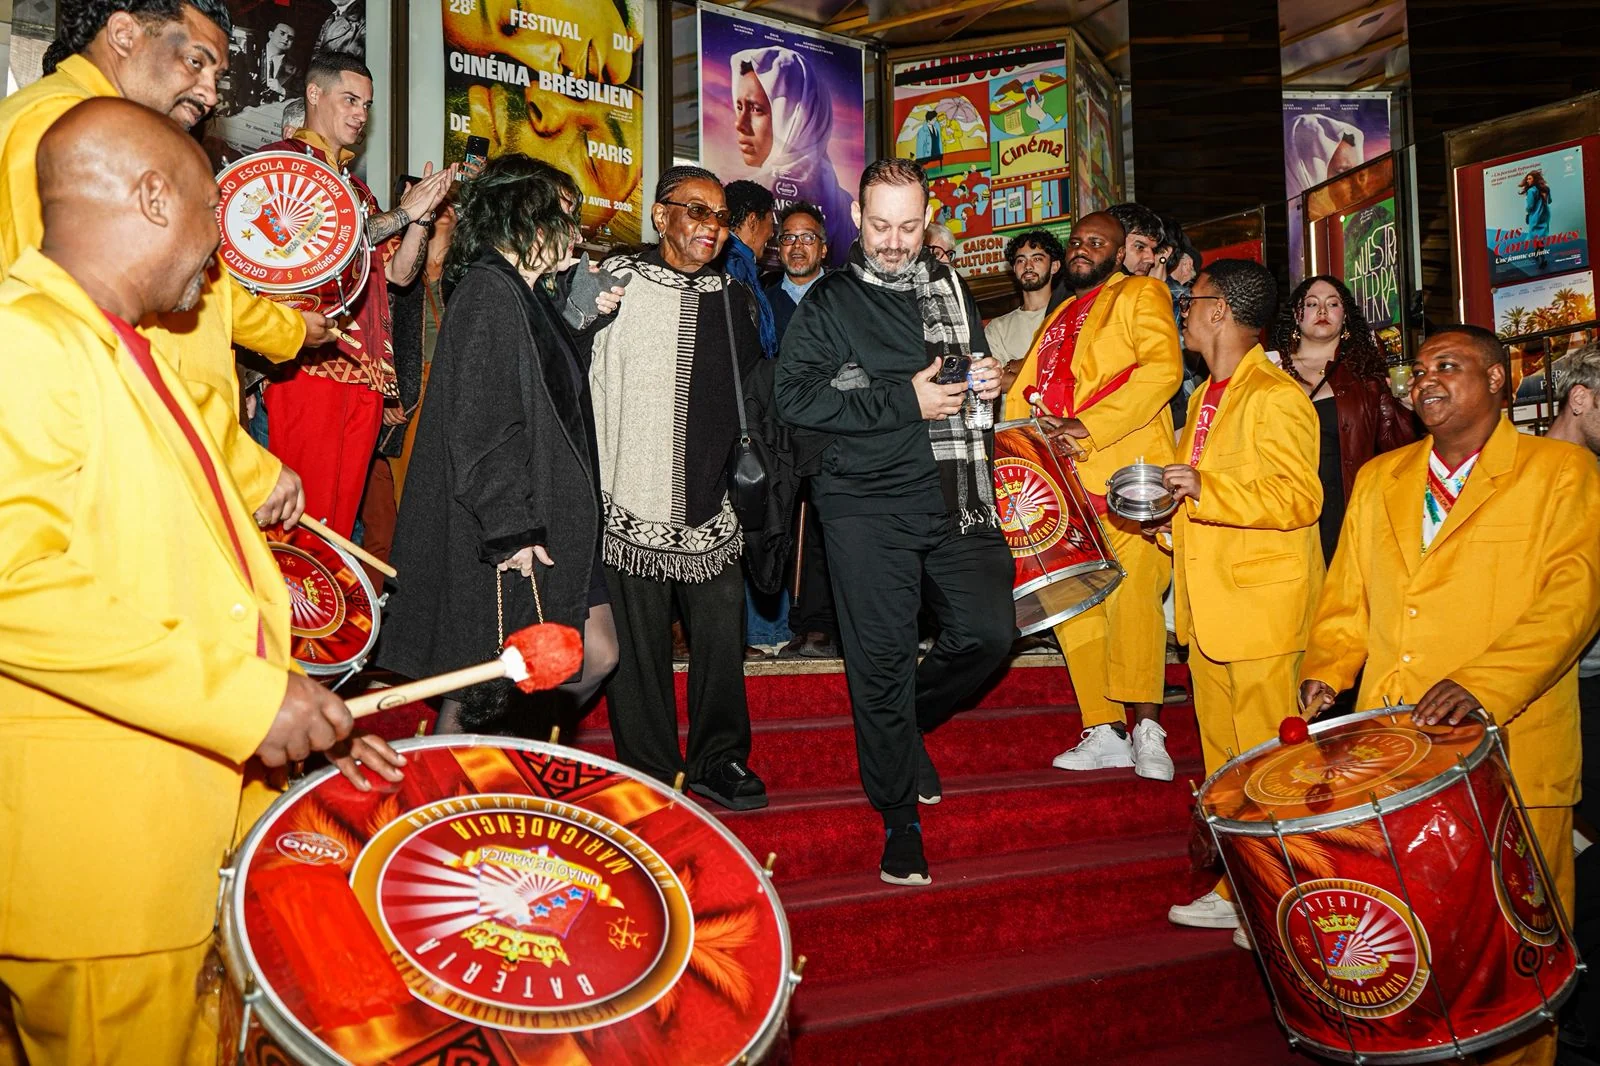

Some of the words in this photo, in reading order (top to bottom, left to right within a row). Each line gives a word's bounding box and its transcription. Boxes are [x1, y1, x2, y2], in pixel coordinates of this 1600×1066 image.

[510, 8, 582, 42] FESTIVAL
[613, 33, 633, 53] DU
[450, 51, 531, 88] CINÉMA
[539, 70, 633, 110] BRÉSILIEN
[450, 112, 471, 134] DE
[588, 141, 633, 166] PARIS
[1001, 136, 1064, 167] Cinéma
[238, 161, 284, 180] ESCOLA
[291, 161, 308, 174] DE
[312, 170, 344, 200] SAMBA
[588, 196, 612, 209] AVRIL
[338, 225, 352, 243] 2015
[963, 237, 1003, 255] SAISON
[1494, 229, 1580, 256] Corrientes
[1495, 227, 1522, 242] Las
[334, 243, 345, 256] em
[225, 249, 268, 279] GRÊMIO
[301, 255, 335, 278] Fundada
[406, 797, 480, 828] VENCER
[282, 838, 341, 860] KING
[450, 815, 633, 874] MARICADÊNCIA
[479, 847, 535, 869] MARICÁ
[535, 858, 556, 874] DE
[557, 863, 600, 887] UNIÃO
[414, 937, 595, 1000] BATERIA
[445, 992, 541, 1028] PAULINHO
